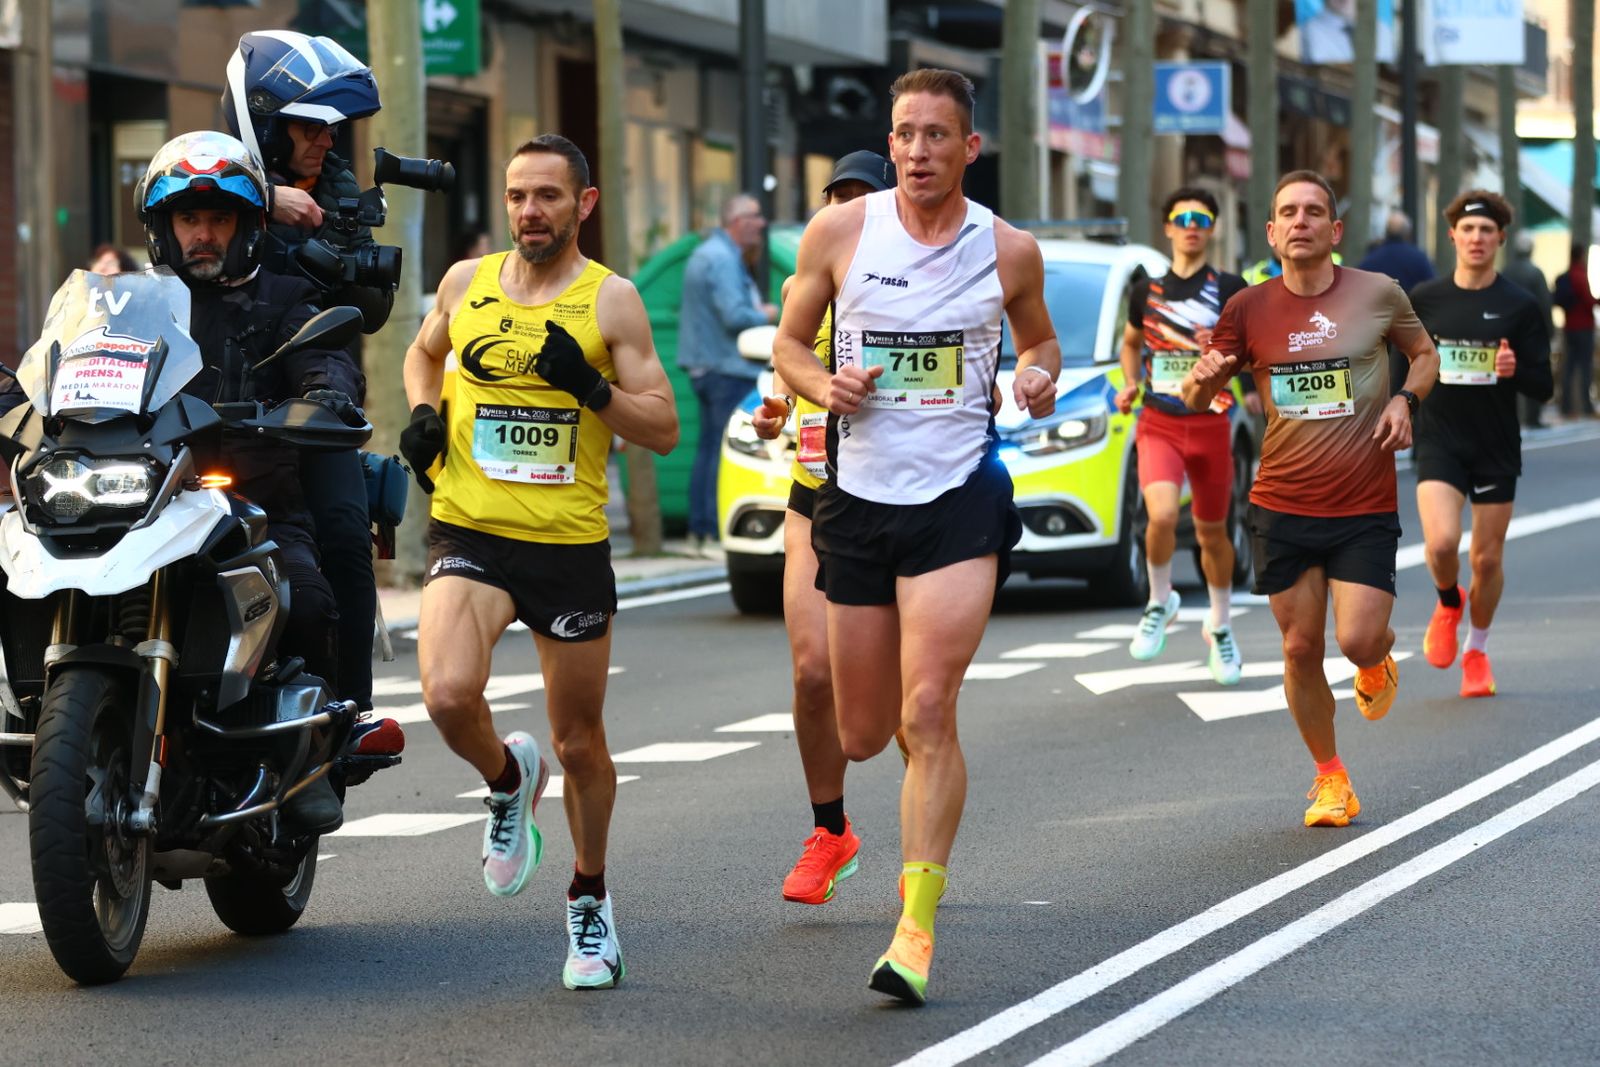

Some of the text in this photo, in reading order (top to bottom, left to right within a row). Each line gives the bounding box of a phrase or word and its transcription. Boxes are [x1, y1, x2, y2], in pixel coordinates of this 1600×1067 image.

[88, 287, 132, 318] tv
[553, 308, 590, 316] HATHAWAY
[1288, 331, 1326, 341] Cañones
[1296, 338, 1323, 347] Duero
[889, 351, 938, 372] 716
[1450, 350, 1488, 363] 1670
[75, 369, 123, 379] PRENSA
[60, 383, 89, 391] MEDIA
[1286, 374, 1336, 393] 1208
[532, 410, 550, 419] 2026
[495, 424, 559, 447] 1009
